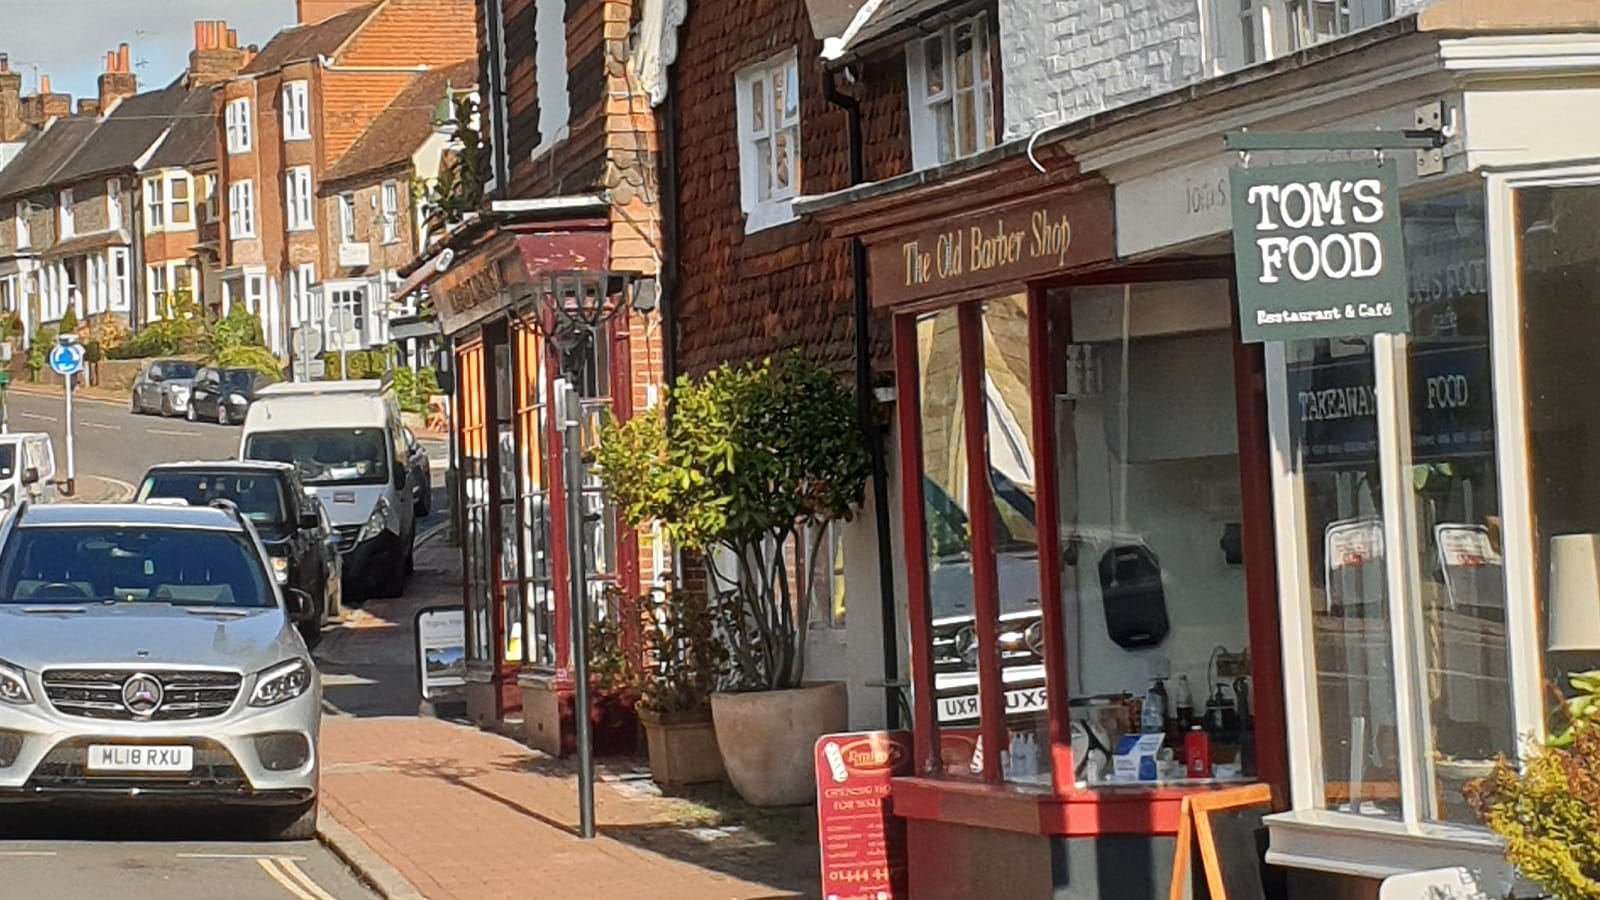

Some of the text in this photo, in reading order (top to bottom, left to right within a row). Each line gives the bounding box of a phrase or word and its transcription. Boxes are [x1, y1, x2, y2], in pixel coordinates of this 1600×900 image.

[1248, 179, 1384, 230] TOM'S
[903, 208, 1071, 286] The Old Barber Shop
[1256, 232, 1382, 283] FOOD
[1256, 302, 1393, 325] Restaurant & Café
[1427, 374, 1469, 409] FOOD
[102, 748, 181, 766] ML18 RXU
